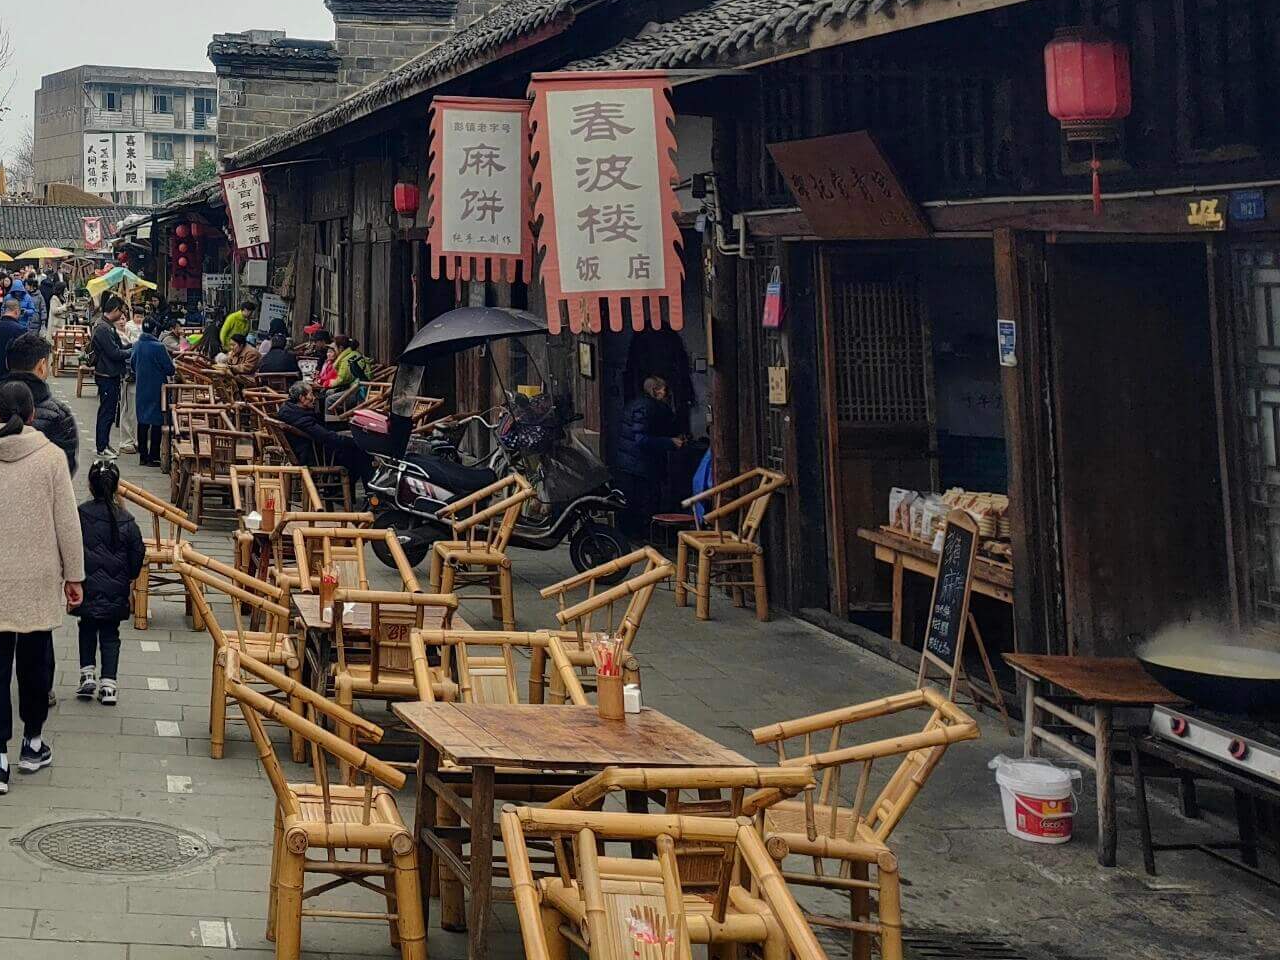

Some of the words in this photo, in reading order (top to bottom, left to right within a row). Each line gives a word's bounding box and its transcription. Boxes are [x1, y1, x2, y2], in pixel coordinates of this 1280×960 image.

[454, 121, 511, 134] 彭镇老字号
[459, 143, 506, 224] 麻饼
[571, 101, 642, 244] 春波楼
[576, 255, 651, 281] 饭店
